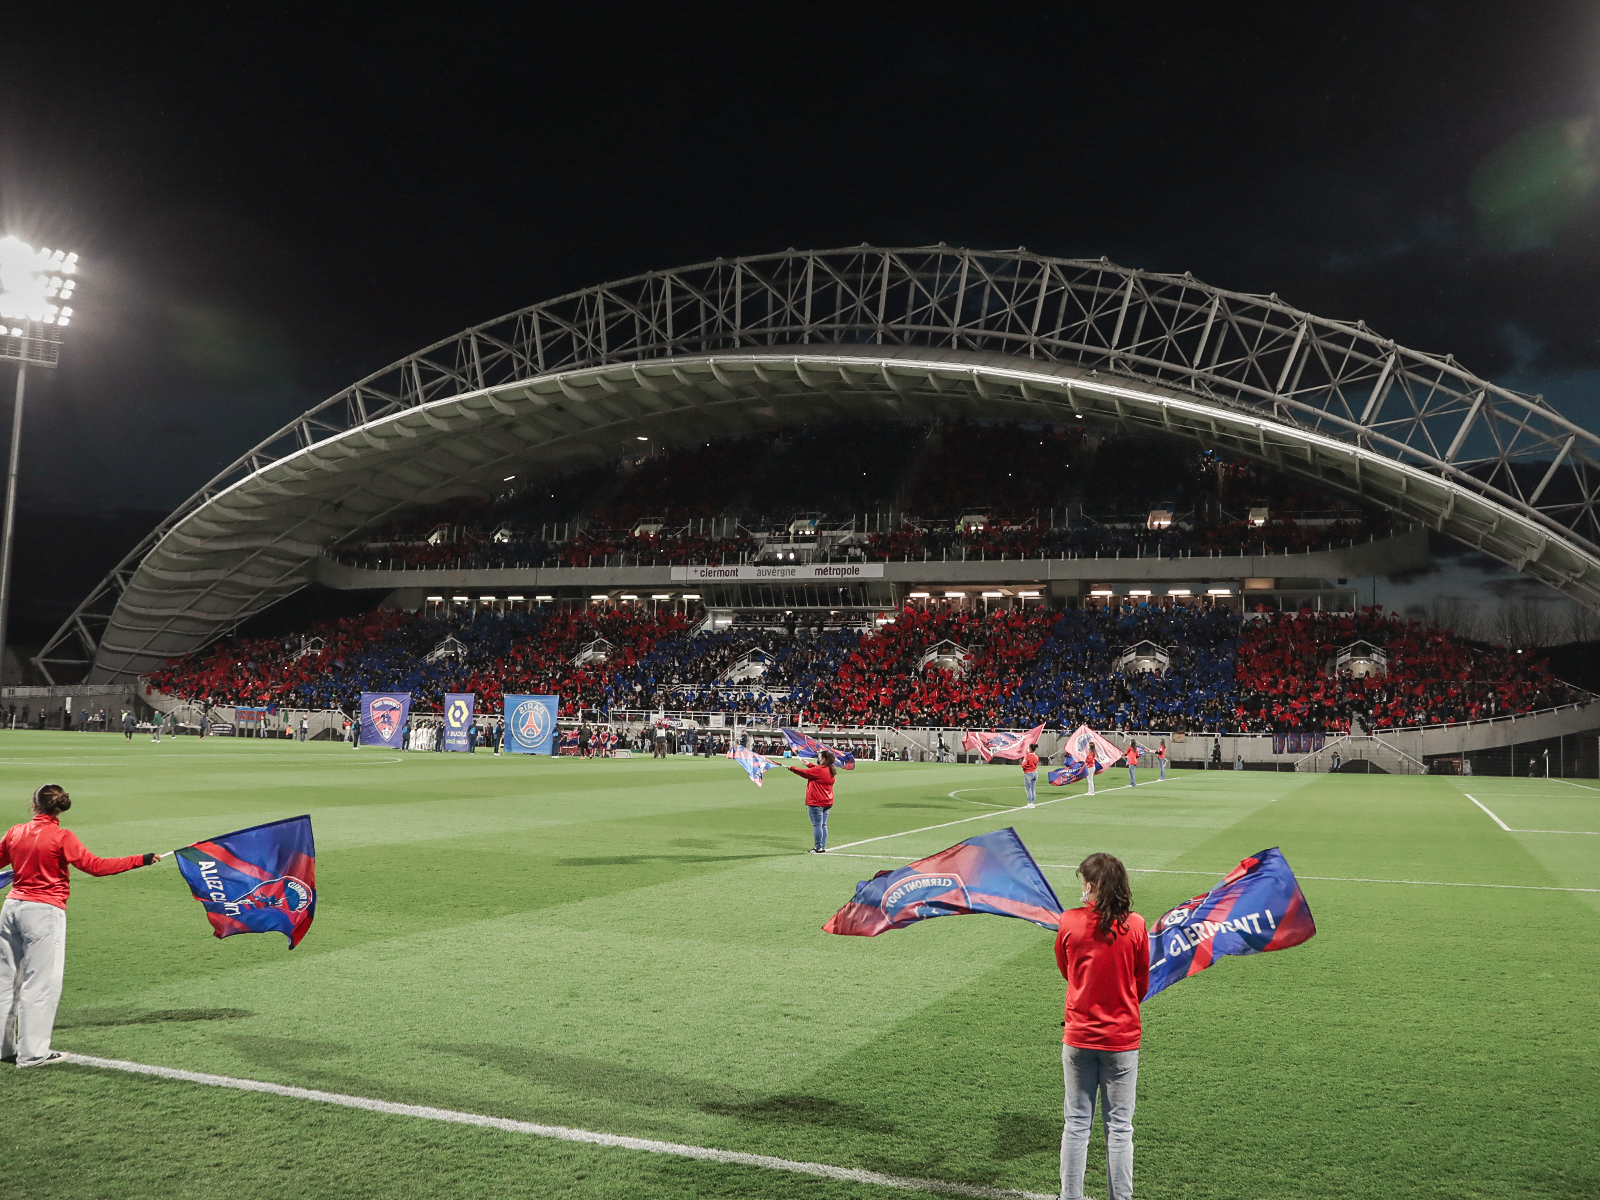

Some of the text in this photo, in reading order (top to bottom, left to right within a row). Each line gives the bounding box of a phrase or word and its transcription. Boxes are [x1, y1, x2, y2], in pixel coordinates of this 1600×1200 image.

[699, 567, 739, 578] clermont
[814, 565, 860, 578] métropole
[198, 860, 225, 891] ALLEZ
